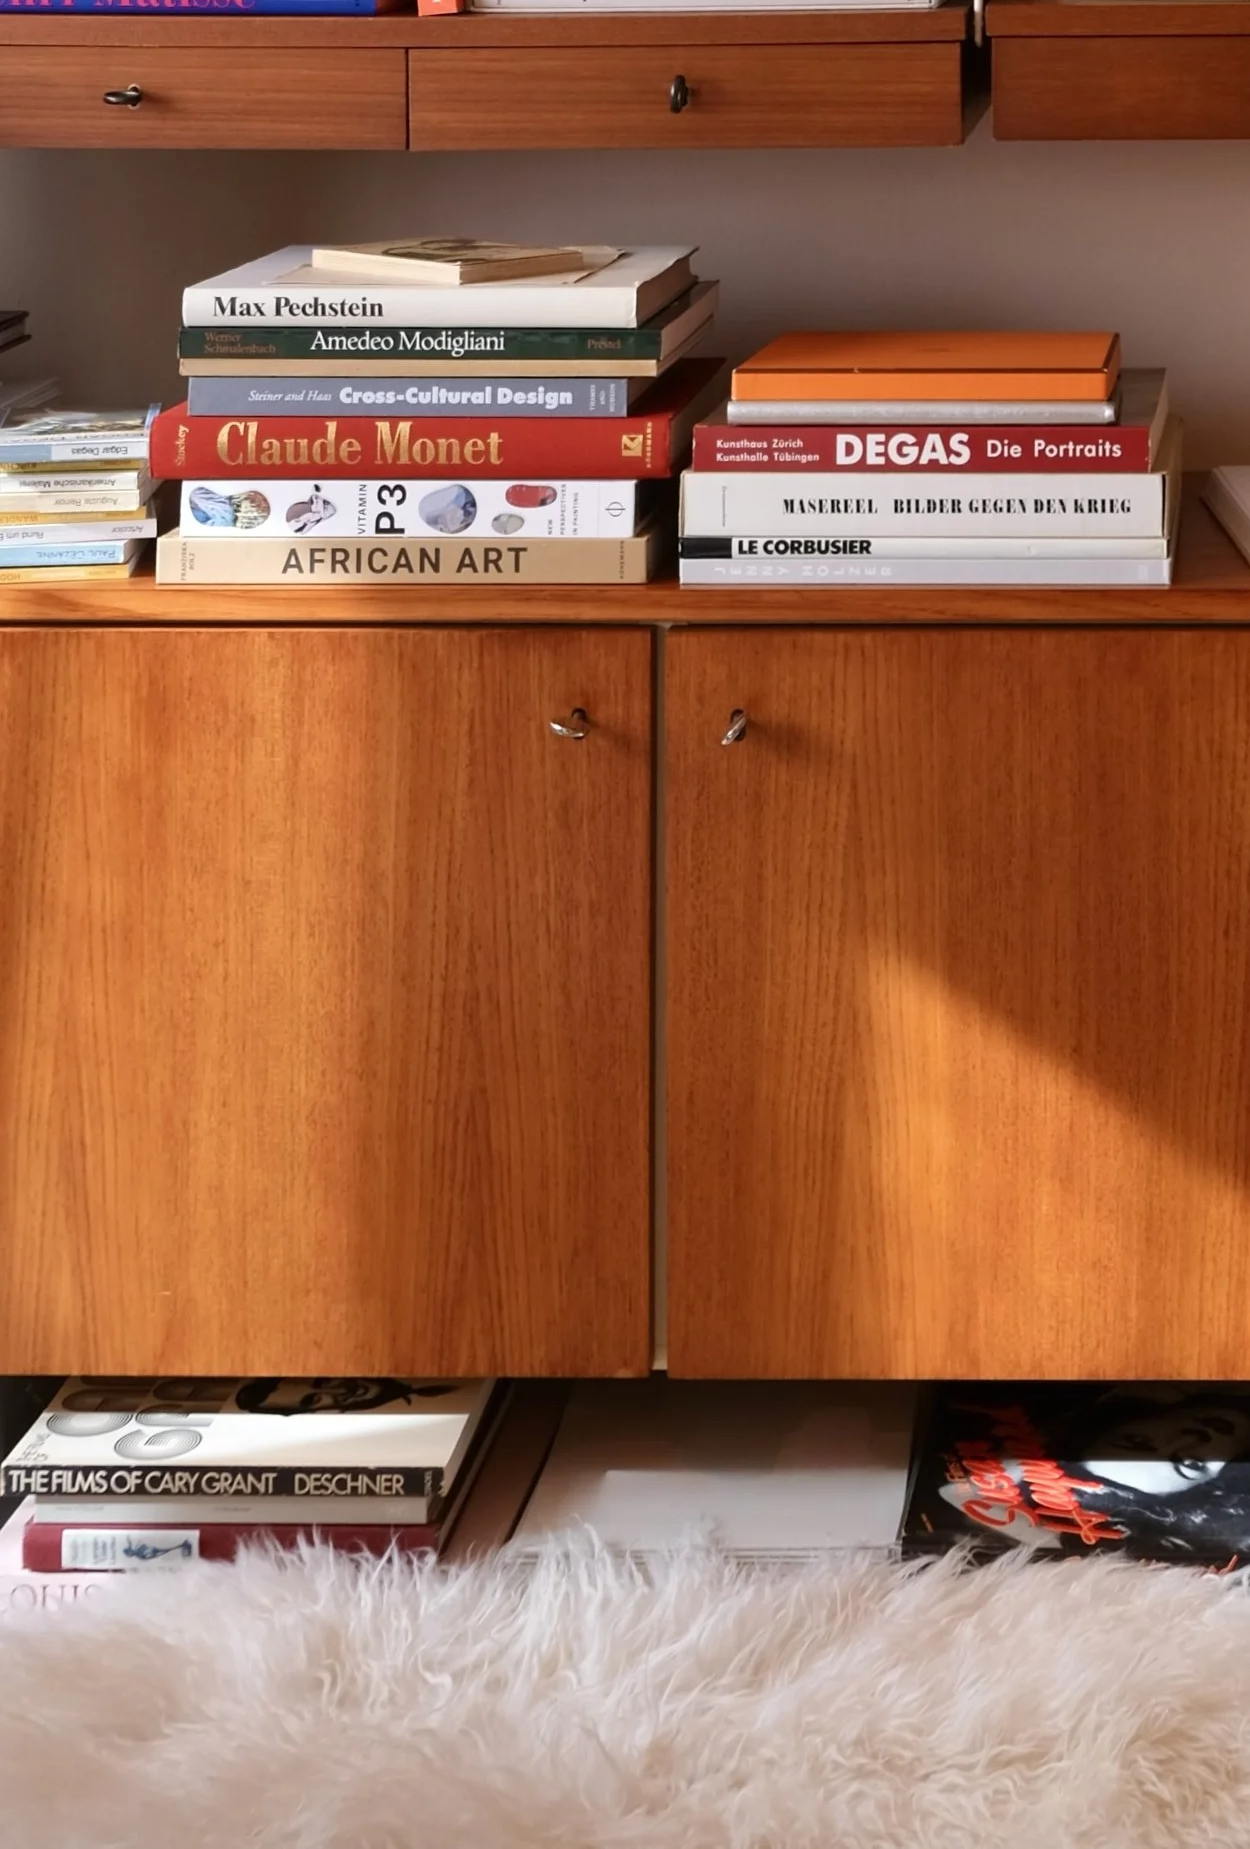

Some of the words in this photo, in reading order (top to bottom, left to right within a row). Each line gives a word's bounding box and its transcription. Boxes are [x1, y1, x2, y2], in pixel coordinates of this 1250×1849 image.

[213, 297, 266, 318] Max
[273, 295, 384, 319] Pechstein
[310, 331, 393, 352] Amedeo
[398, 331, 505, 357] Modigliani
[217, 421, 362, 466] Claude
[374, 421, 504, 465] Monet
[716, 439, 767, 448] Kunsthaus
[772, 438, 803, 448] Zürich
[835, 433, 971, 465] DEGAS
[986, 440, 1022, 458] Die
[1033, 439, 1122, 458] Portraits
[716, 453, 768, 462] Kunsthalle
[773, 452, 820, 463] Tübingen
[738, 540, 758, 555] LE
[763, 539, 872, 555] CORBUSIER
[282, 547, 441, 574] AFRICAN
[455, 547, 528, 573] ART
[9, 1471, 49, 1493] THE
[52, 1471, 107, 1493] FILMS
[110, 1471, 143, 1494] OF
[144, 1471, 199, 1494] CARY
[201, 1472, 278, 1494] GRANT
[294, 1473, 404, 1495] DESCHNER
